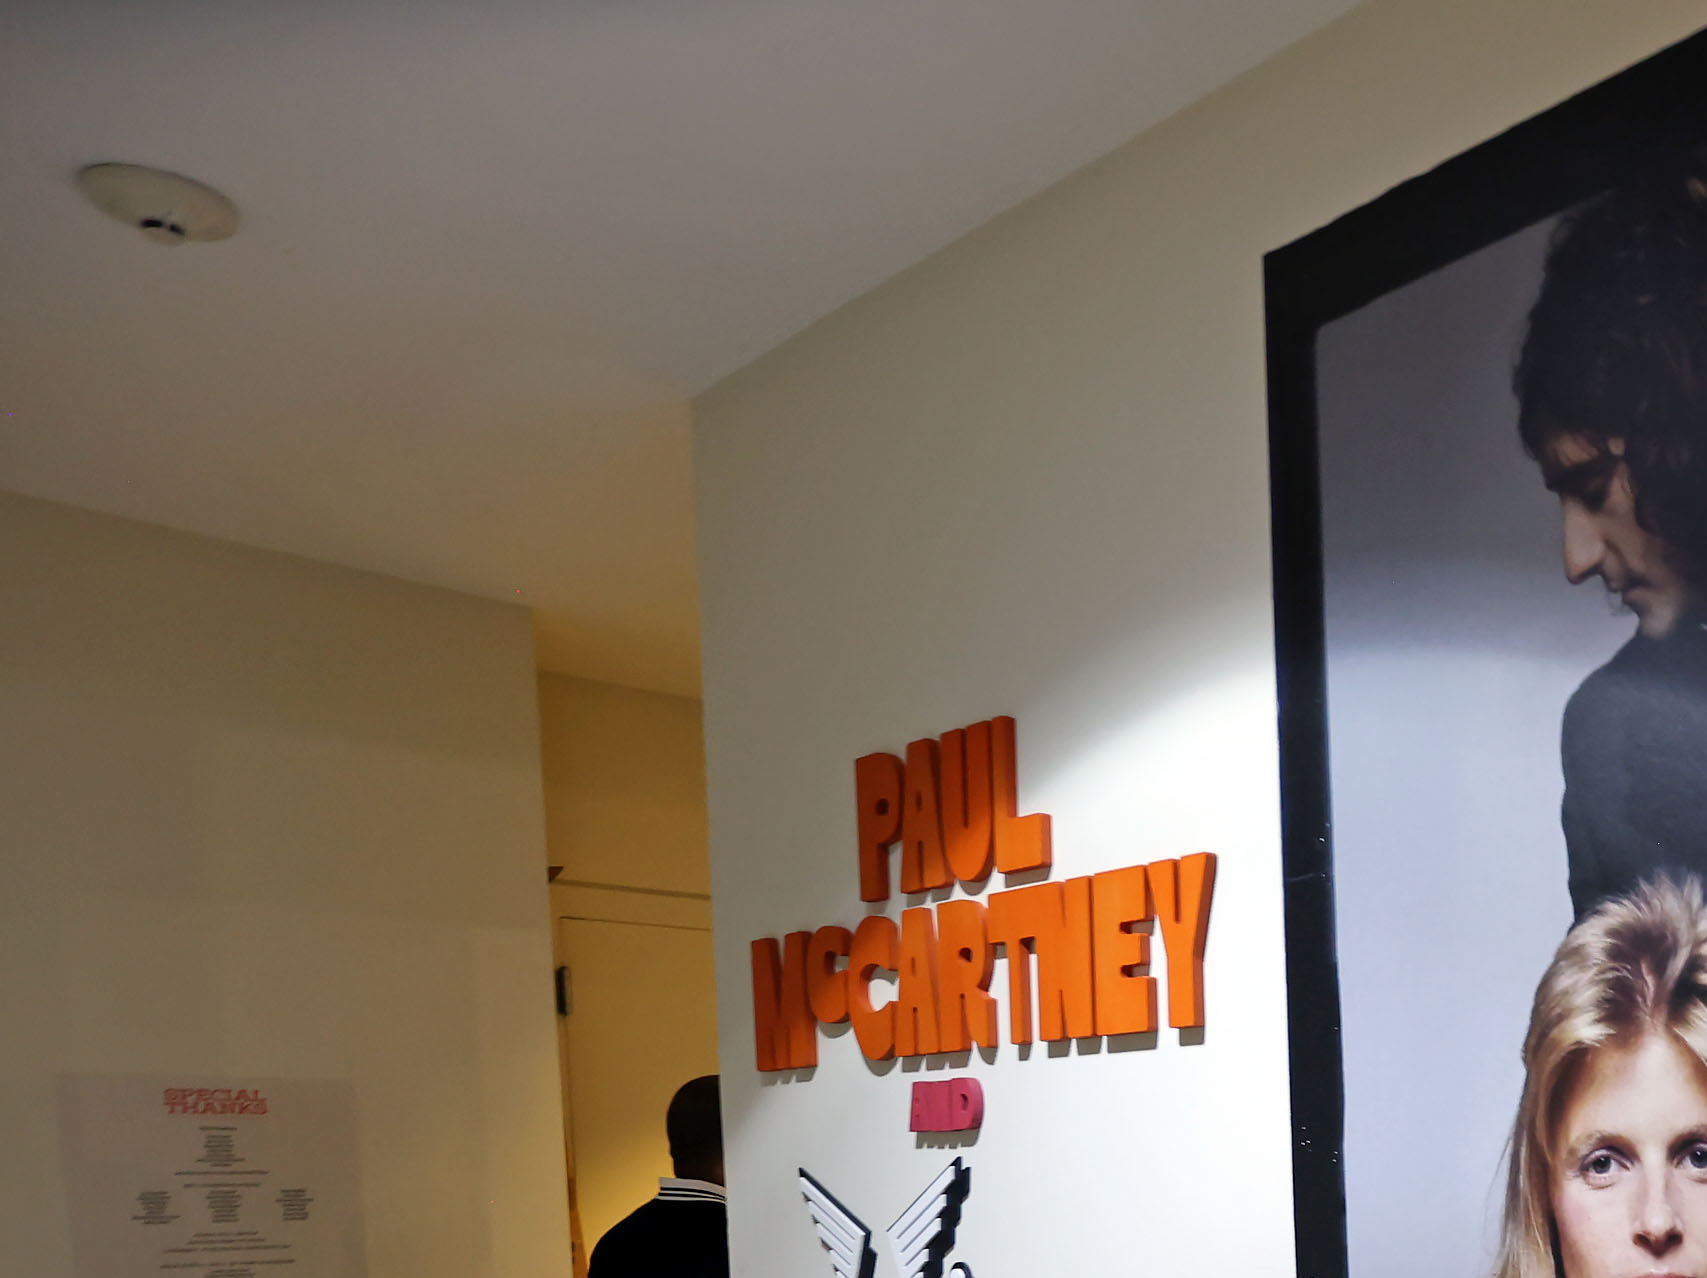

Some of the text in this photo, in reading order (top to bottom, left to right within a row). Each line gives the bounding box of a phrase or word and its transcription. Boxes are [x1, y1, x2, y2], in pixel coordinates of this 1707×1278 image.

[856, 716, 1052, 902] PAUL
[163, 1088, 267, 1104] SPECIAL
[167, 1102, 269, 1115] THANKS
